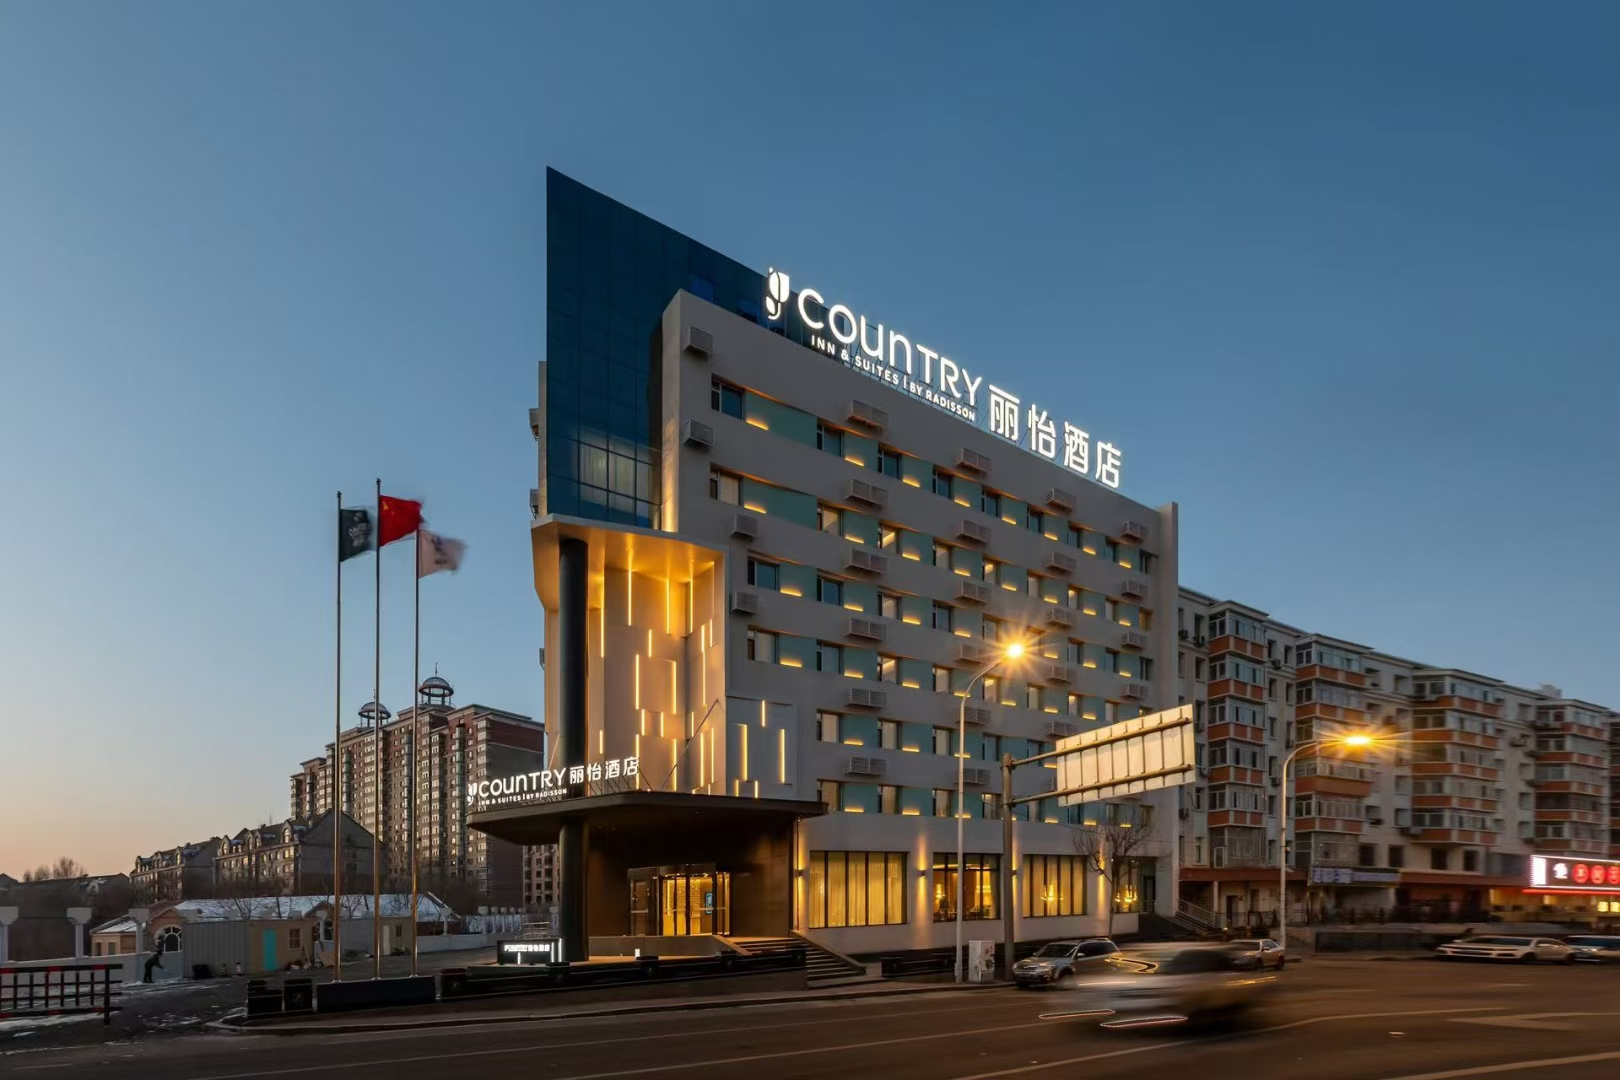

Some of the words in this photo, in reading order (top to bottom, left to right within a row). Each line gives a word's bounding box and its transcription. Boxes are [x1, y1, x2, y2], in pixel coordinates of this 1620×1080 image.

[811, 334, 836, 355] INN
[840, 349, 850, 362] &
[854, 355, 899, 385] SUITES
[909, 381, 923, 396] BY
[925, 389, 976, 422] RADISSON
[988, 384, 1122, 489] 丽怡酒店
[497, 795, 521, 804] SUITES
[535, 788, 567, 799] RADISSON
[569, 756, 640, 785] 丽怡酒店
